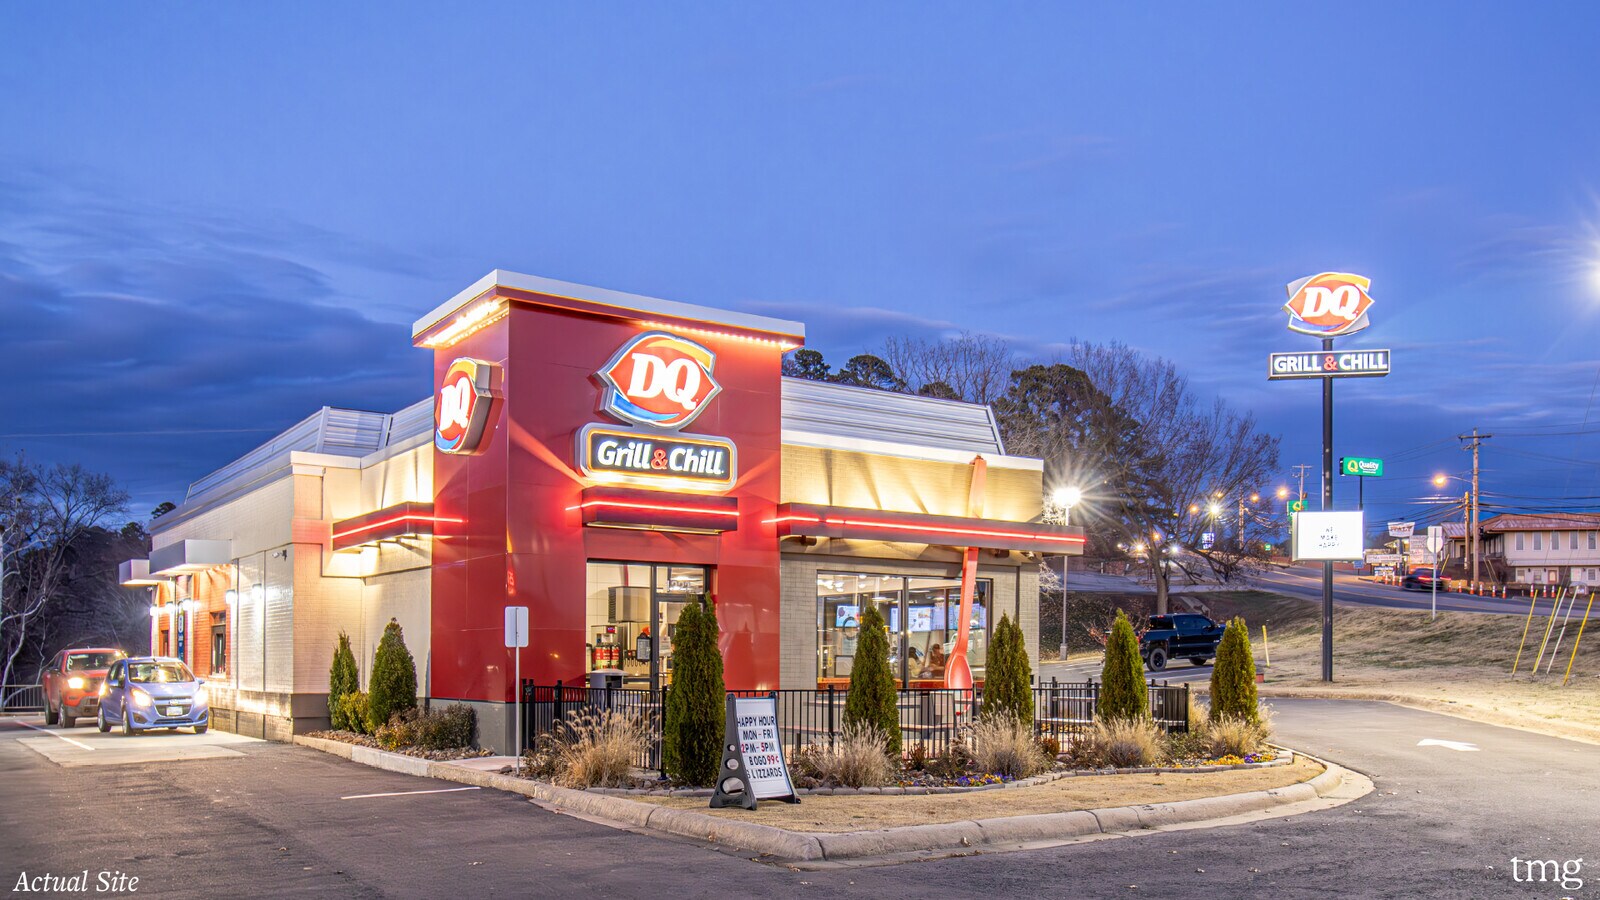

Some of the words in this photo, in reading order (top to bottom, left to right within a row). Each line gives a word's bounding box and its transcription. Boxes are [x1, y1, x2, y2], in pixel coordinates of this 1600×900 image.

[1301, 284, 1360, 320] DQ
[1274, 355, 1322, 372] GRILL
[1323, 354, 1338, 371] &
[1339, 353, 1388, 370] CHILL
[627, 352, 700, 410] DQ
[439, 377, 470, 431] DQ
[1359, 460, 1379, 471] Quality
[737, 716, 757, 727] HAPPY
[758, 716, 776, 726] HOUR
[763, 729, 773, 739] FRI
